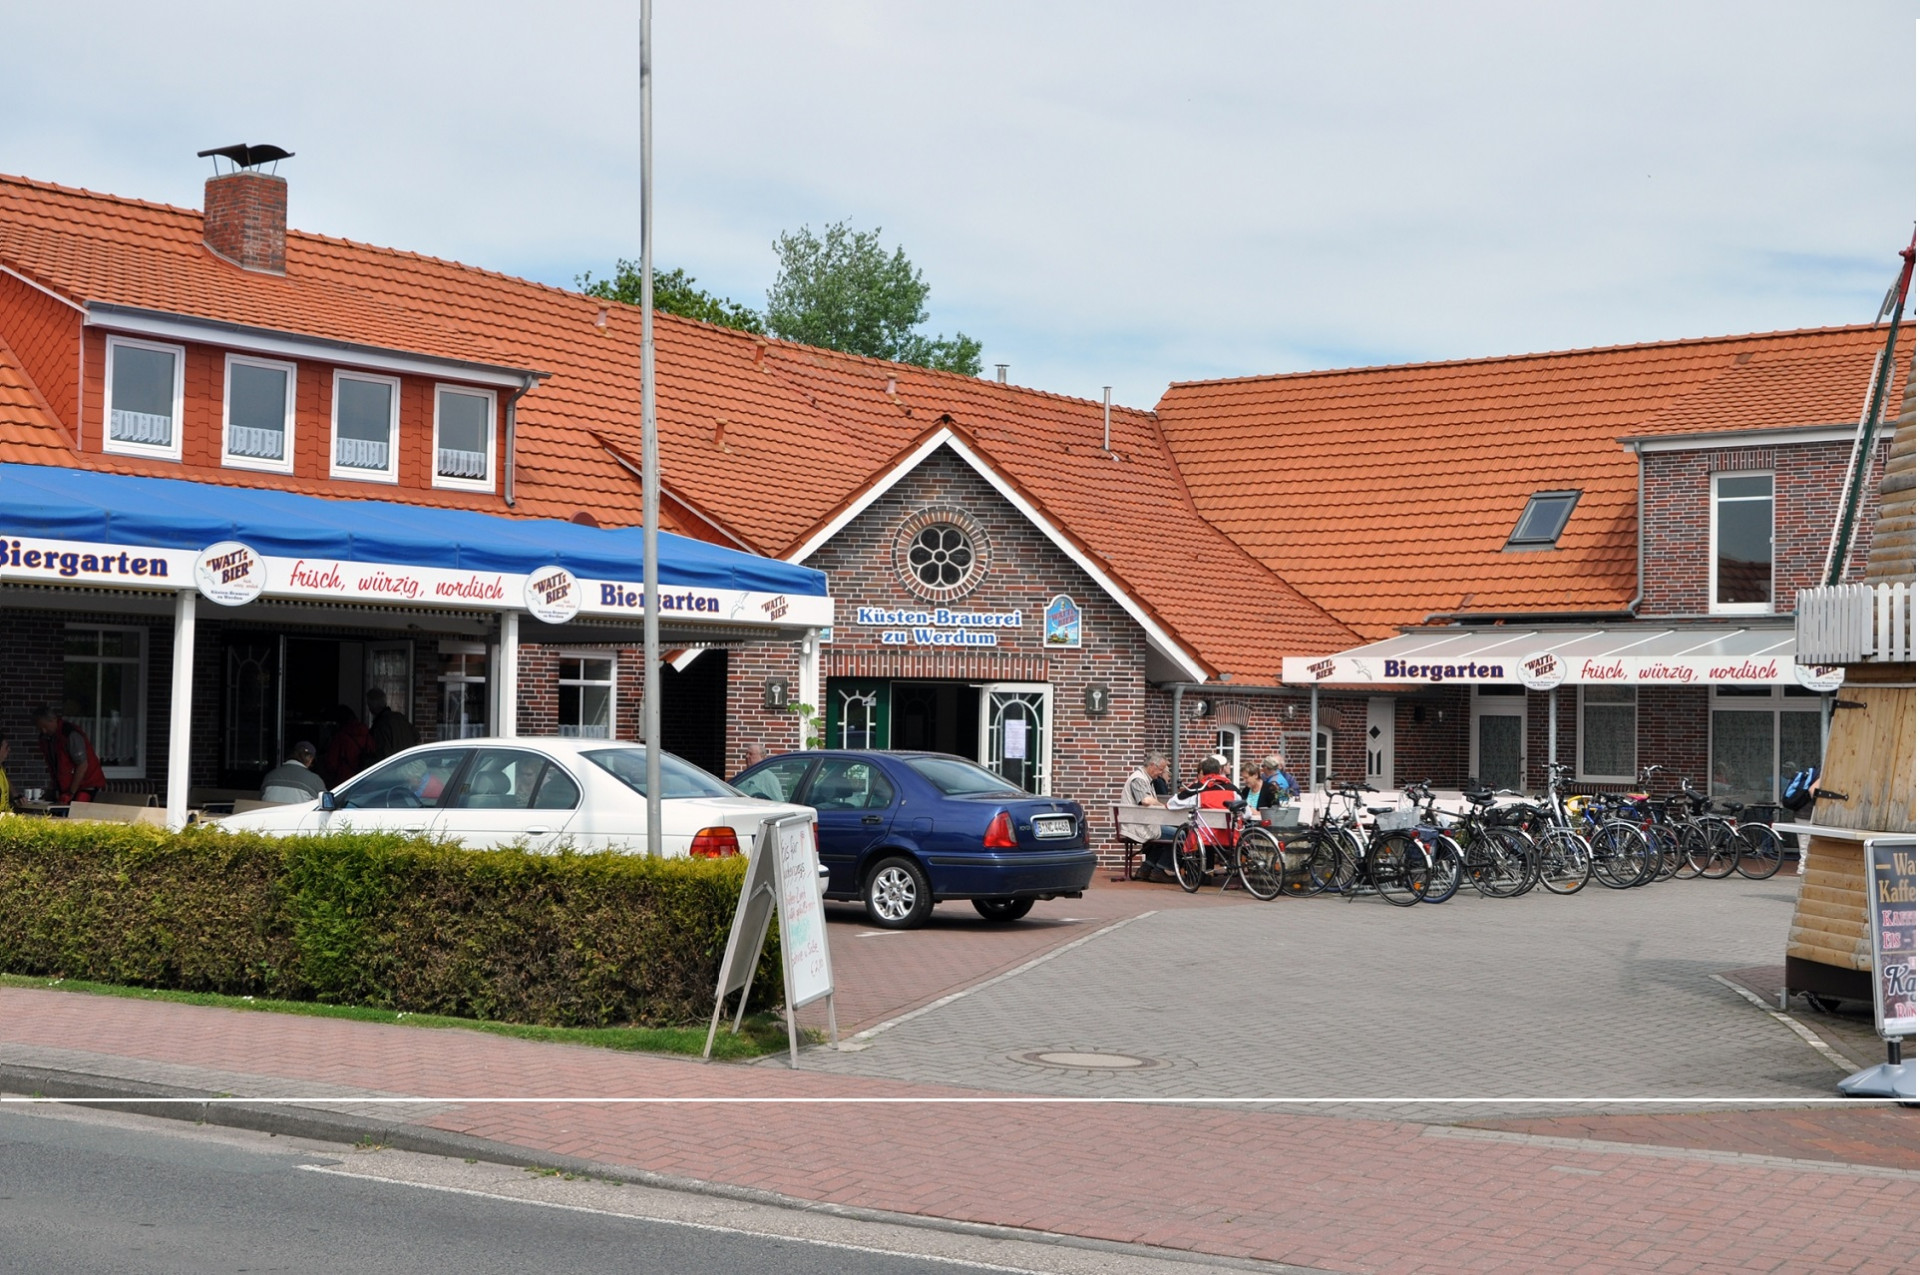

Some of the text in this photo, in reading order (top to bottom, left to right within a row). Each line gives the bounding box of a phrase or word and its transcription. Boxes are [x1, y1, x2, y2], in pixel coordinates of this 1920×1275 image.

[289, 560, 504, 600] frisch, würzig, nordisch
[859, 608, 1021, 625] Küsten-Brauerei
[884, 628, 996, 645] zu Werdum
[1384, 660, 1504, 681] Biergarten
[1581, 659, 1778, 683] frisch, würzig, nordisch
[1893, 853, 1916, 876] Wa
